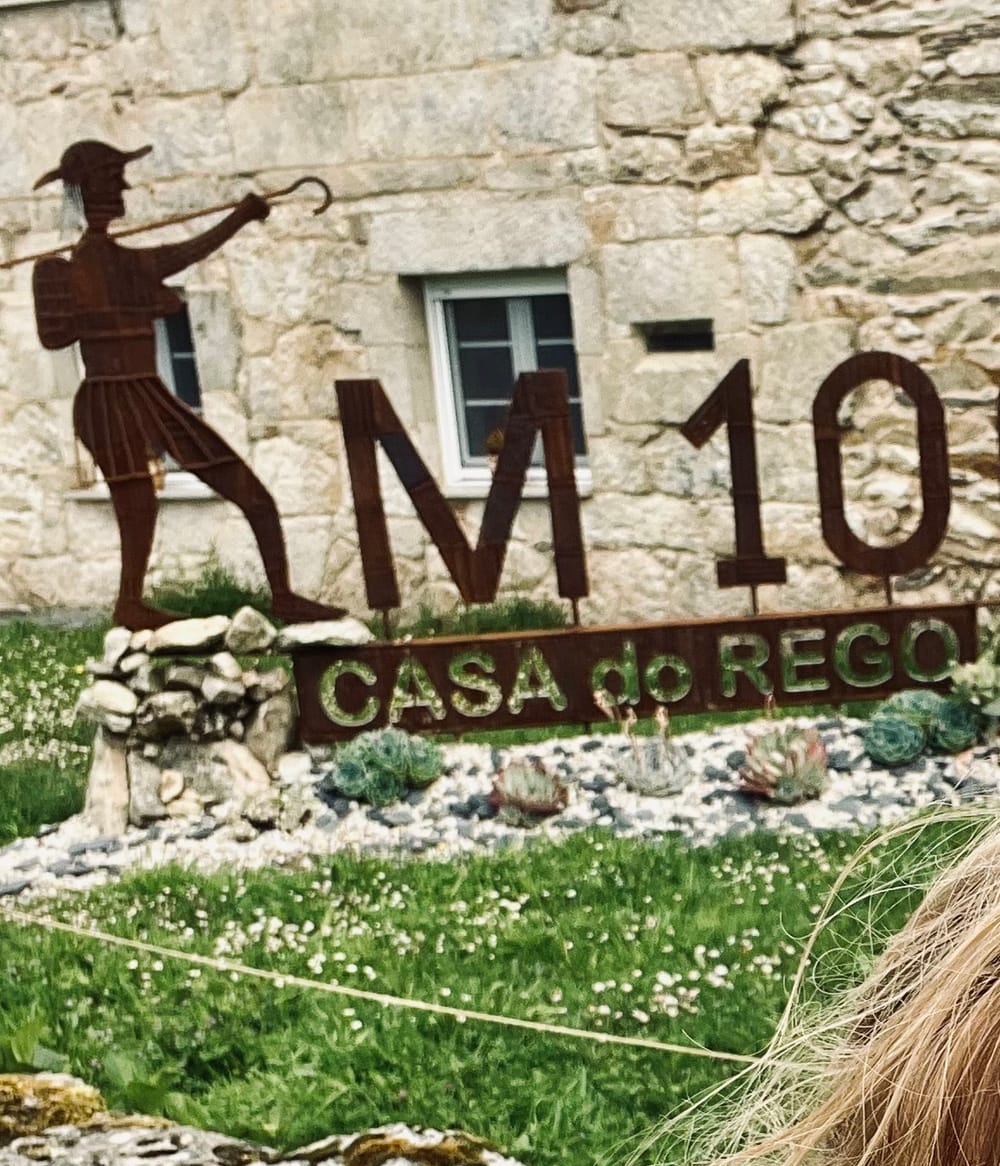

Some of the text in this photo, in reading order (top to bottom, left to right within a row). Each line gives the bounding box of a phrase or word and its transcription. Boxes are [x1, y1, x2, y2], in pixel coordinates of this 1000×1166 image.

[334, 367, 591, 609] M
[319, 618, 961, 727] CASA do REGO
